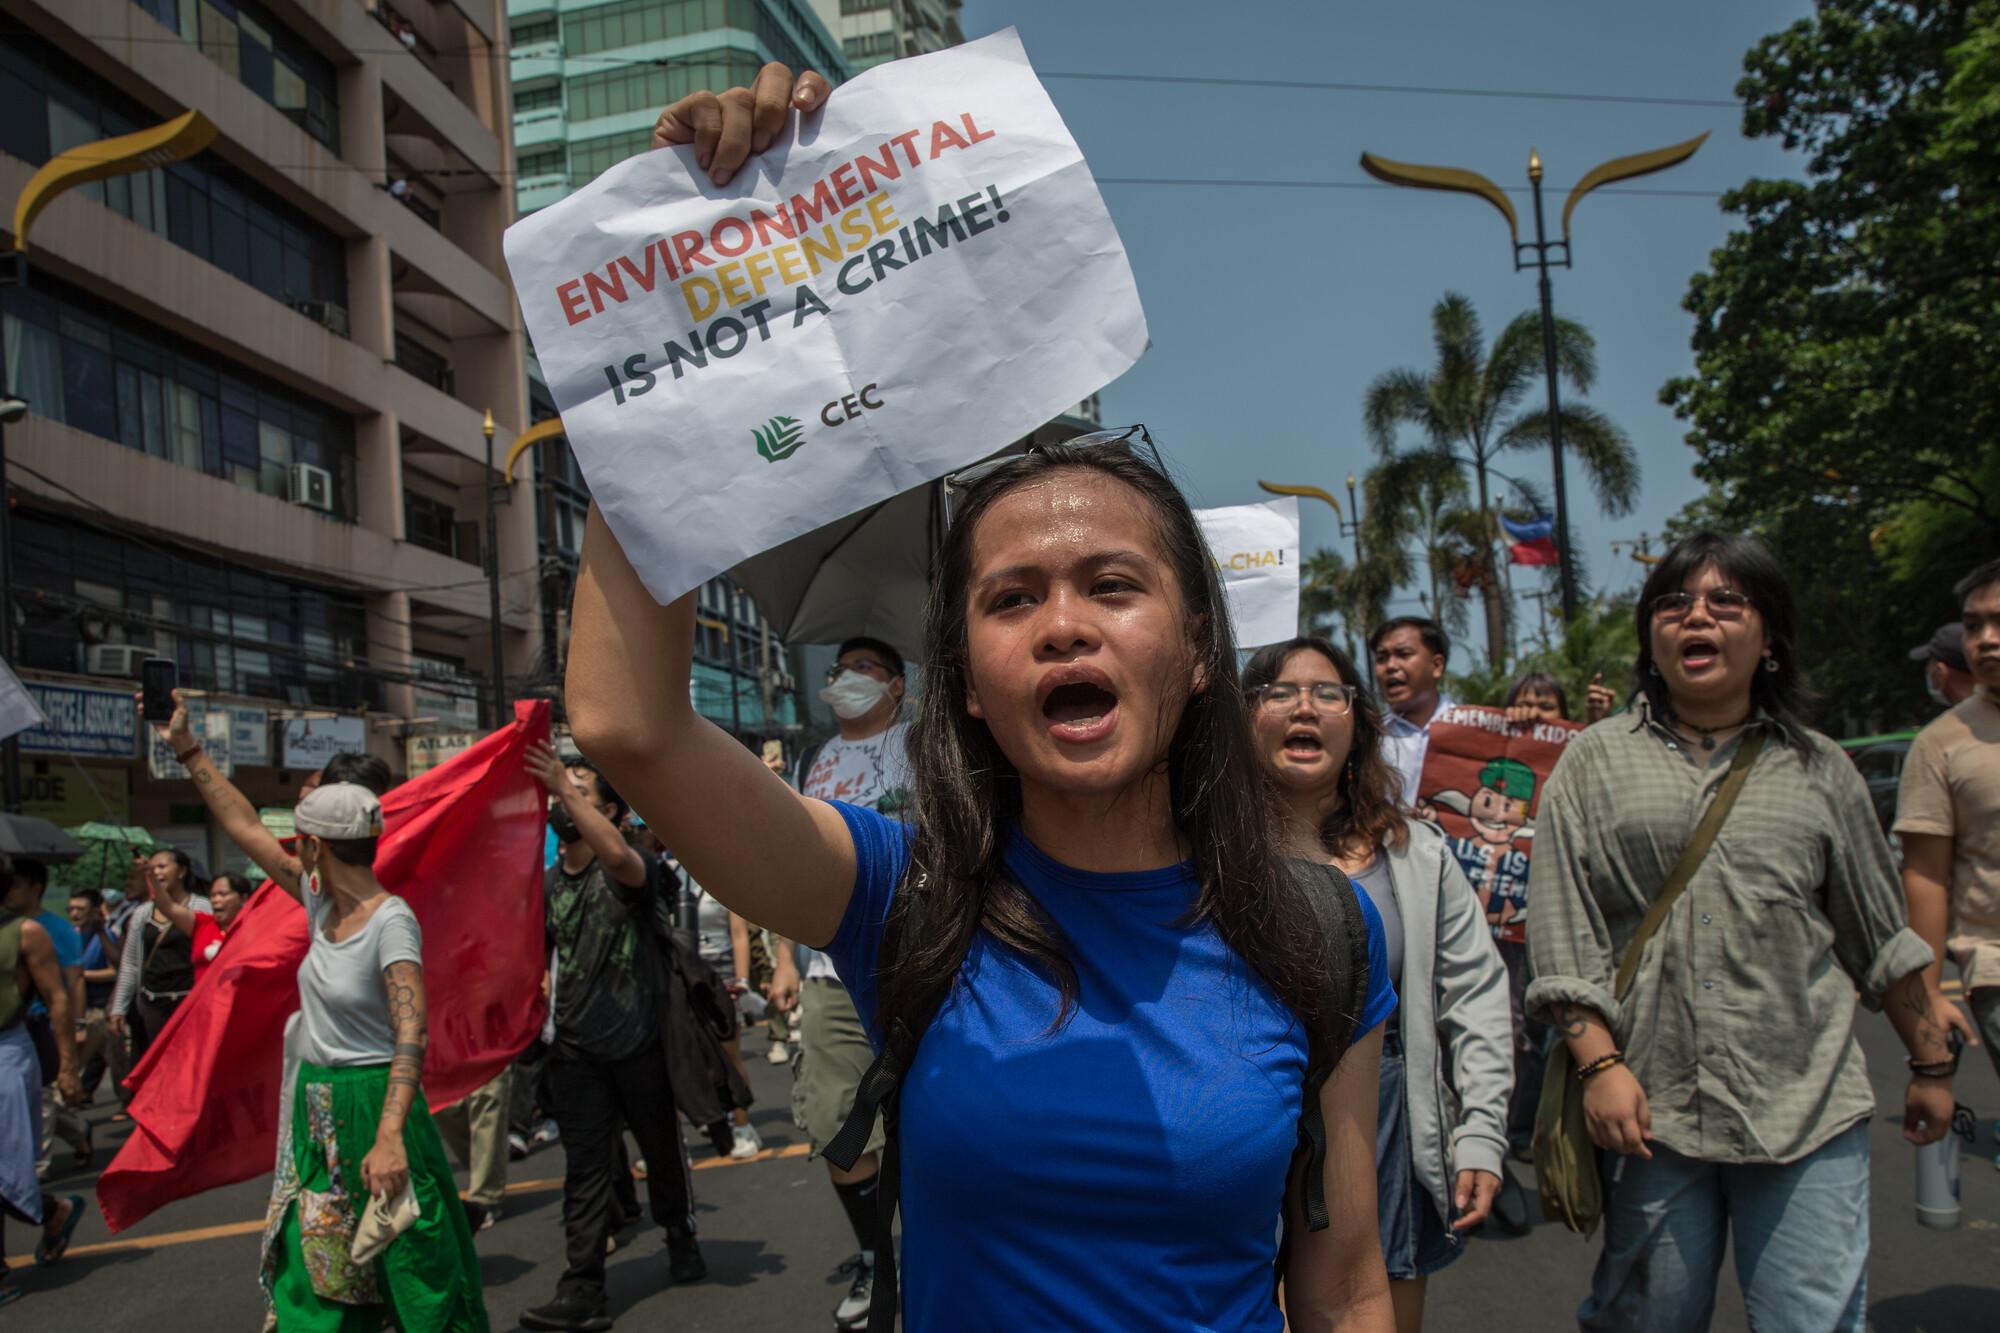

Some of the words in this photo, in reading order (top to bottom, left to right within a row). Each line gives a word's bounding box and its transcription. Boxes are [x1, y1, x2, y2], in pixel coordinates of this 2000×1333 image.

[556, 112, 996, 326] ENVIRONMENTAL
[681, 191, 900, 323] DEFENSE
[604, 353, 657, 405] IS
[663, 300, 771, 379] NOT
[793, 284, 831, 328] A
[836, 184, 1011, 294] CRIME!
[820, 383, 885, 428] CEC
[417, 737, 466, 751] ATLAS
[1436, 708, 1523, 738] EMEMBER
[1503, 850, 1528, 875] IS
